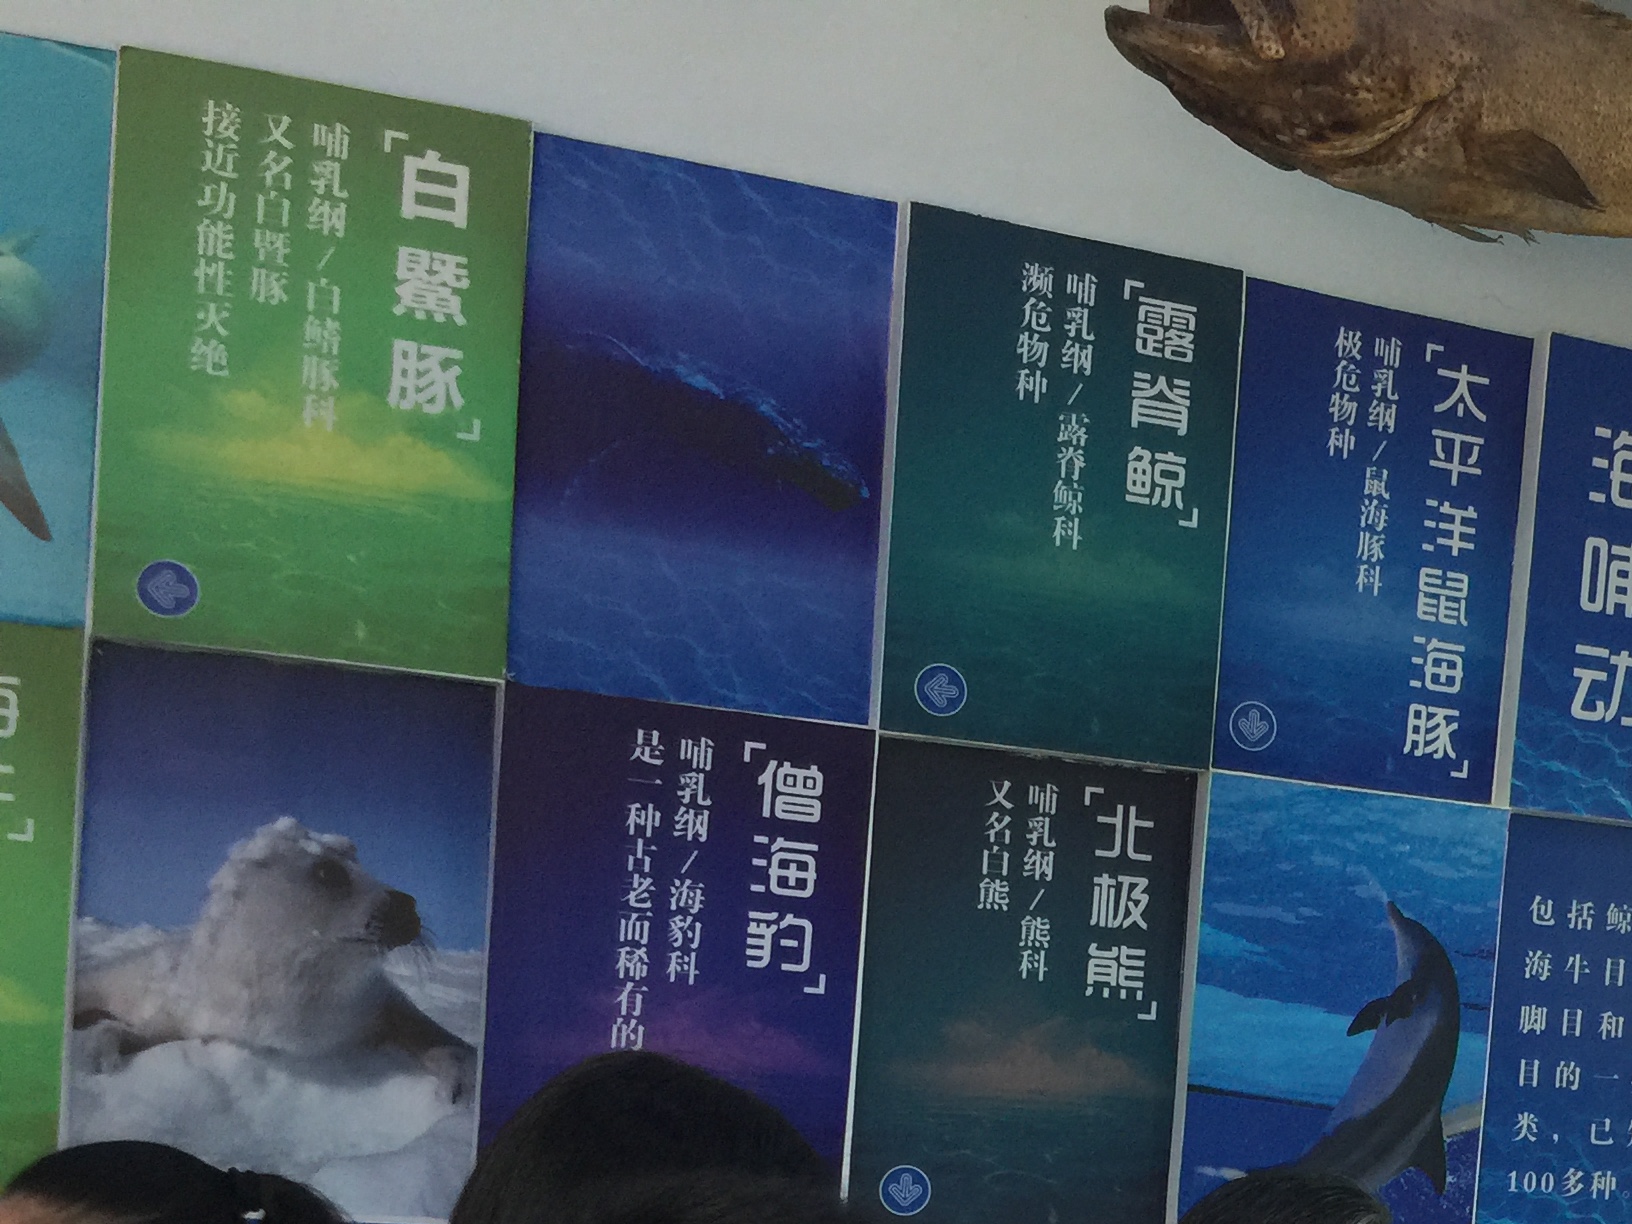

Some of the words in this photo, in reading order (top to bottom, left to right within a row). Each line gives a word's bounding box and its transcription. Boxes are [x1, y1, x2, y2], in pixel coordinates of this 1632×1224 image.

[190, 99, 242, 378] 接近功能性灭绝
[1016, 262, 1054, 404] 濒危物种
[1052, 273, 1098, 551] 哺乳纲/露脊鲸科
[1326, 326, 1362, 460] 极危物种
[1355, 336, 1403, 597] 哺乳纲/鼠海豚科
[610, 729, 665, 1051] 是一种古老而稀有的
[666, 737, 715, 986] 哺乳纲/海豹科
[977, 779, 1014, 912] 又名白熊
[1017, 783, 1057, 981] 哺乳纲/熊科
